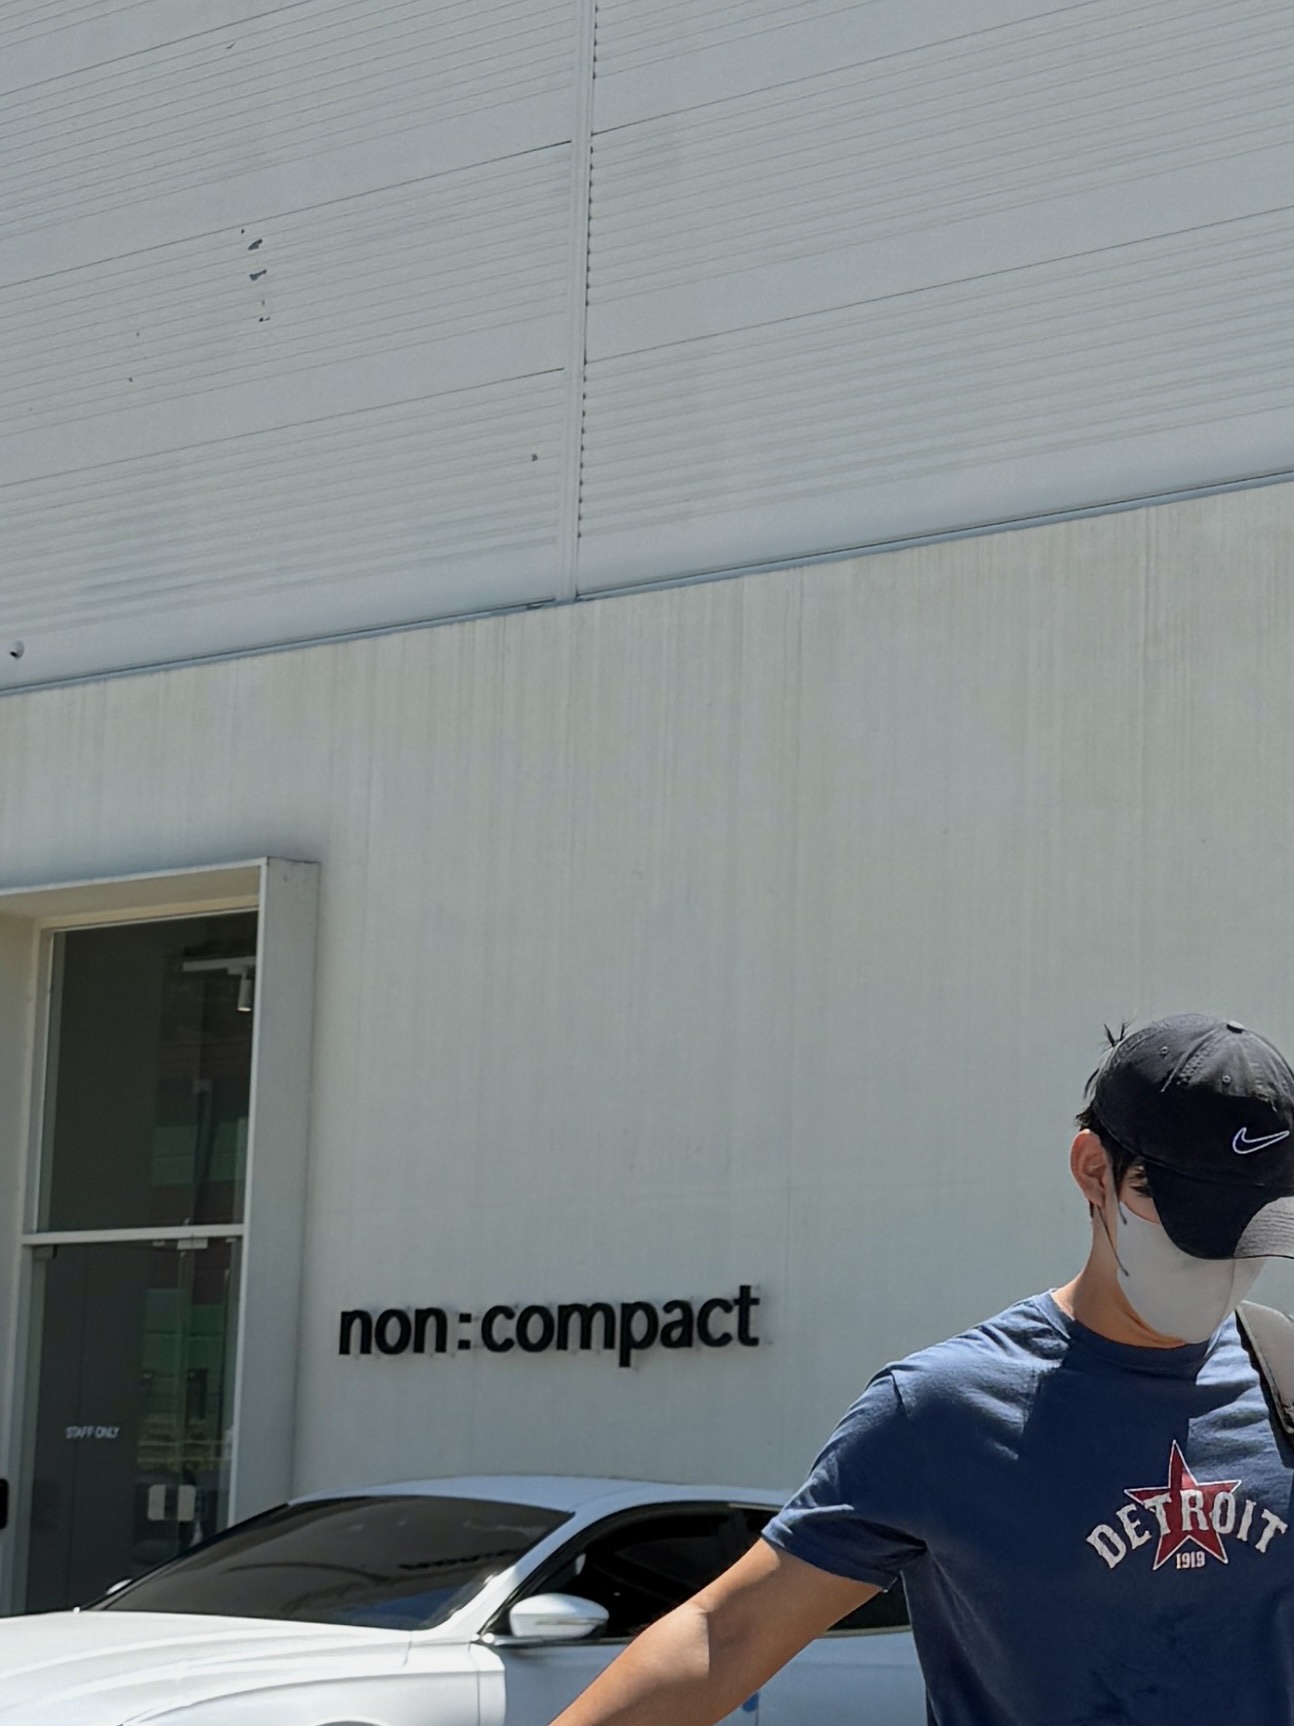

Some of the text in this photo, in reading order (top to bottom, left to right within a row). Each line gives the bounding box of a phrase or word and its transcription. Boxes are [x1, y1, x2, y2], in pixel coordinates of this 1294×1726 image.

[338, 1284, 762, 1369] non:compact
[1085, 1489, 1289, 1569] DETROIT
[1175, 1550, 1207, 1570] 1919
